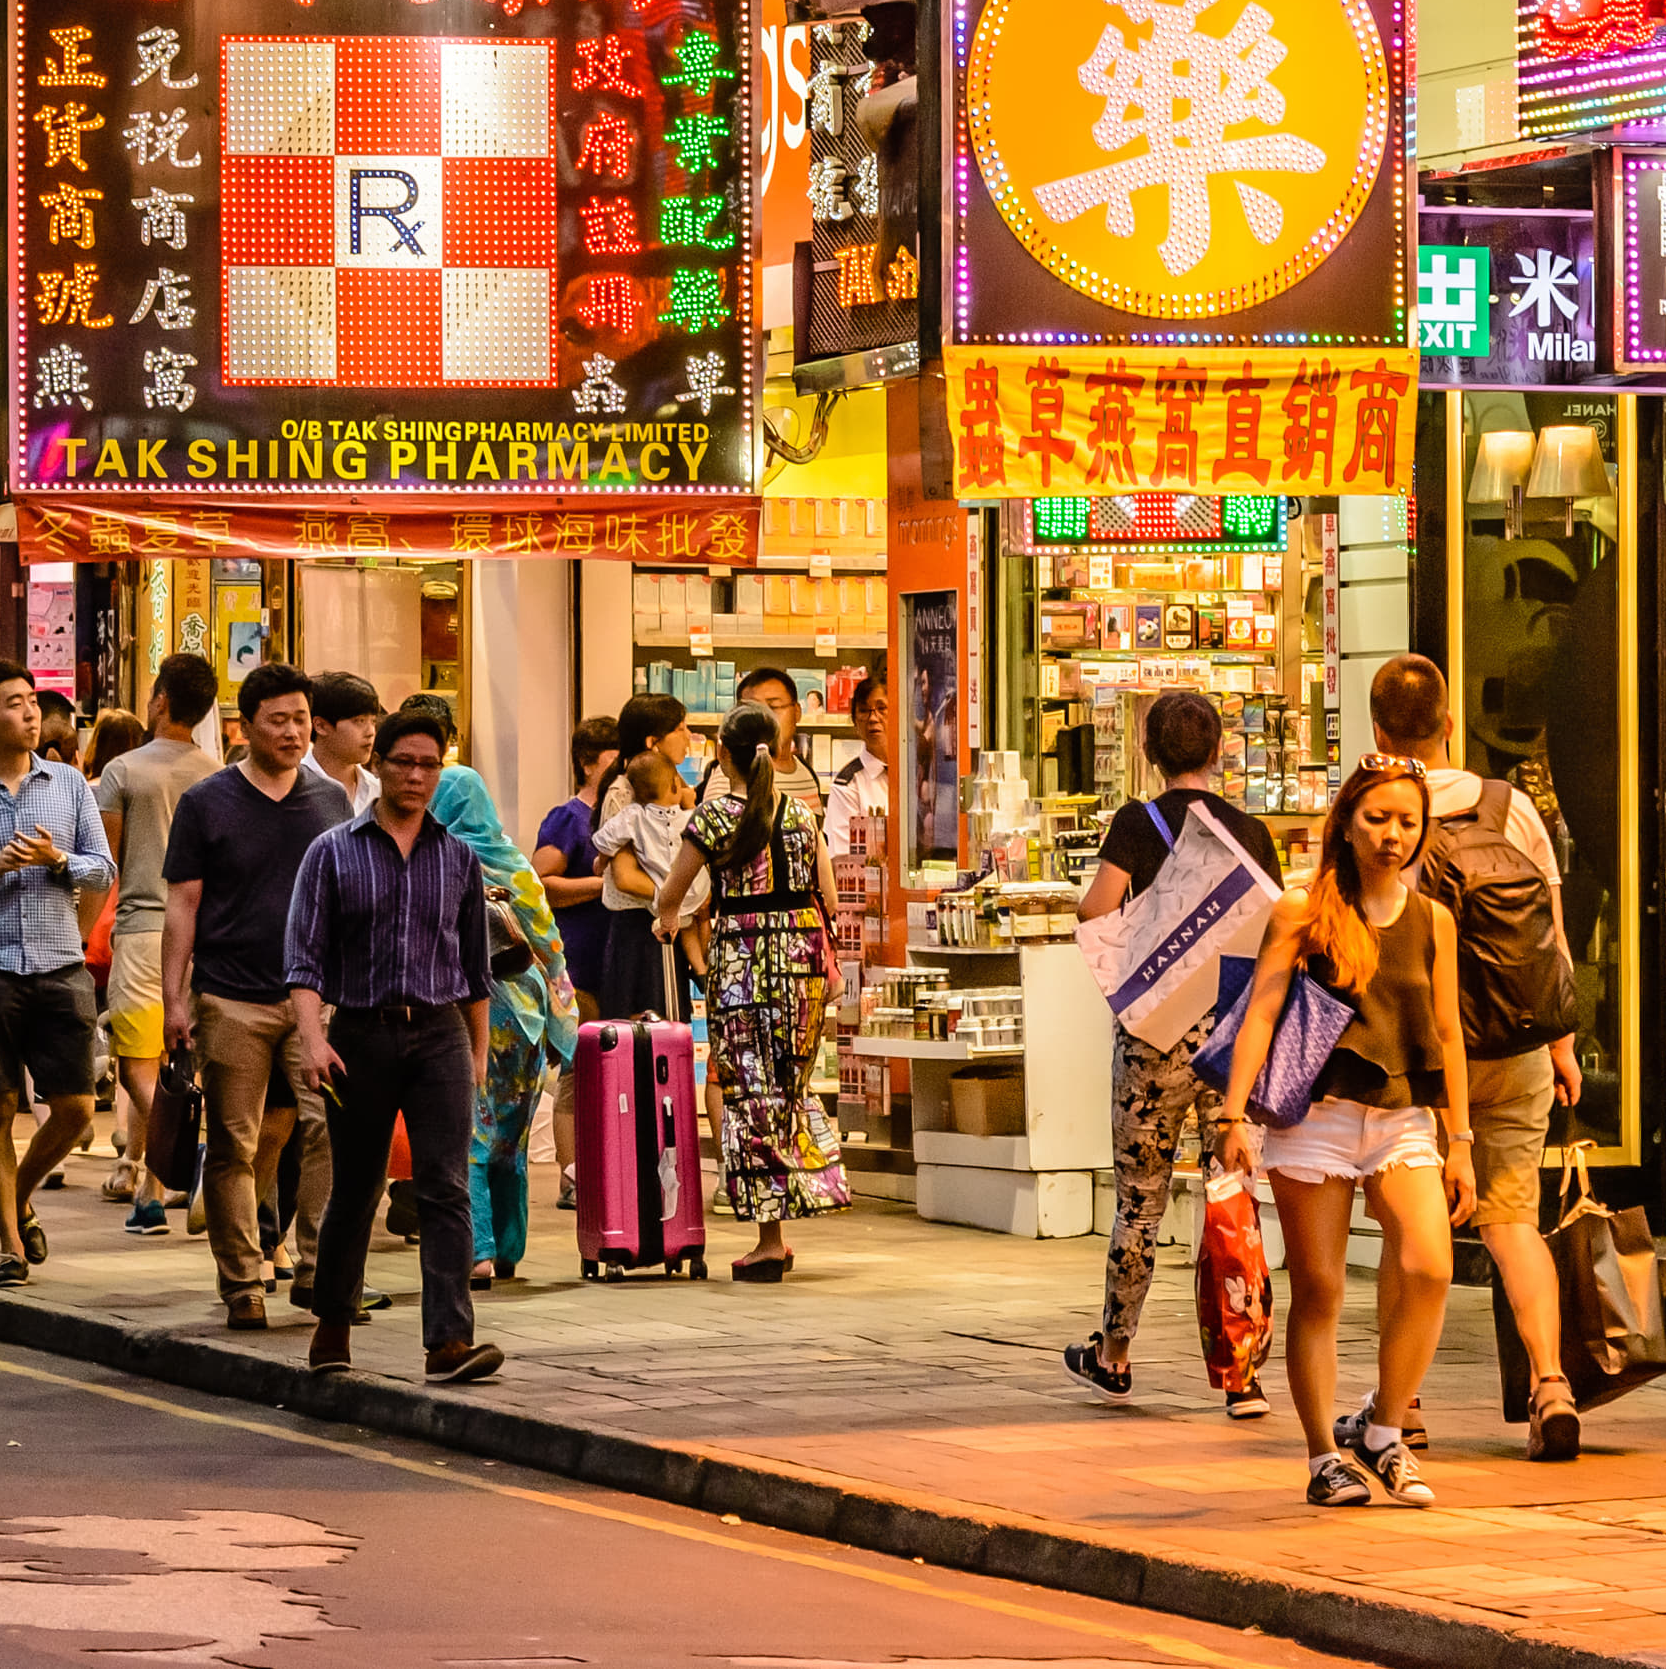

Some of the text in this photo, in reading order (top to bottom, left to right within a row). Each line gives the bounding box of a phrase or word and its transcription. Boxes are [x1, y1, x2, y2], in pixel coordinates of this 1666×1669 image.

[281, 420, 710, 443] O/B TAK LIMITED
[58, 438, 710, 481] TAK SHING PHARMACY
[1142, 900, 1221, 982] HANNAH
